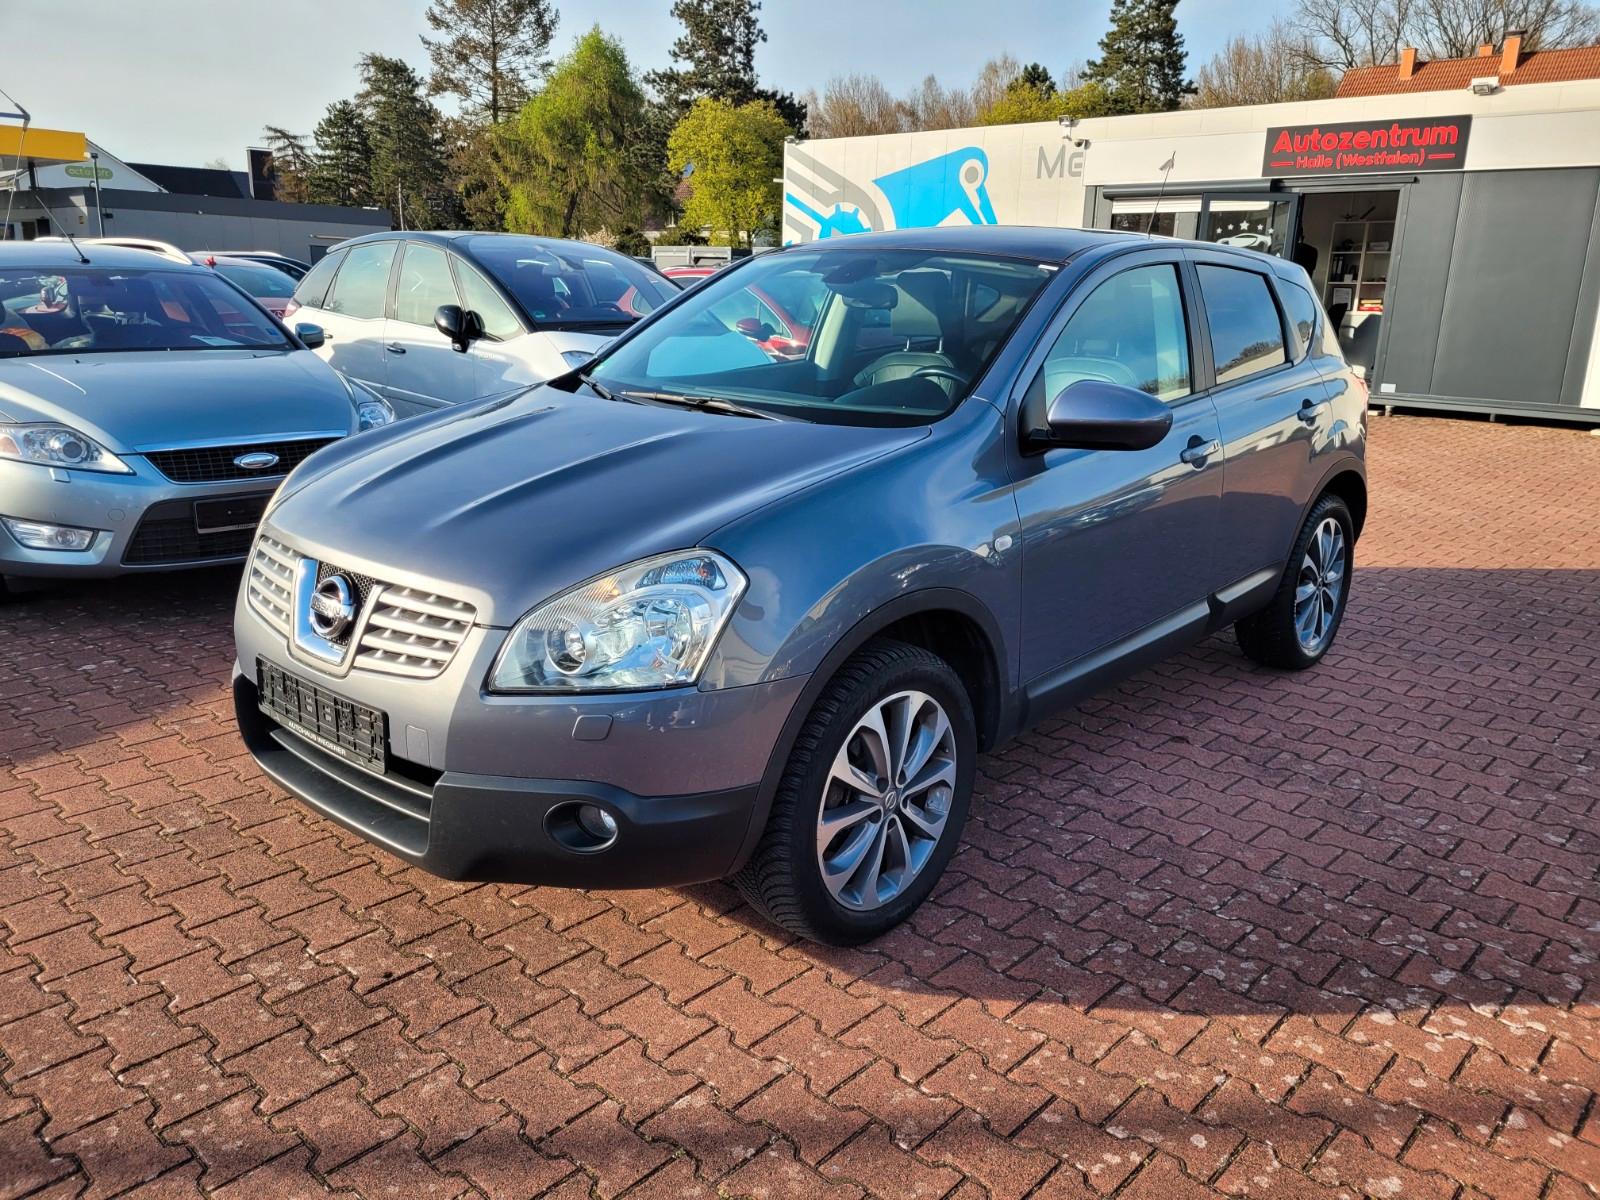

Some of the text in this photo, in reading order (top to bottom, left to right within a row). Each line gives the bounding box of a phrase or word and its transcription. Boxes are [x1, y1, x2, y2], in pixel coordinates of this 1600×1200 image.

[1272, 123, 1459, 154] Autozentrum
[1296, 149, 1426, 169] Halle (Westfalen)
